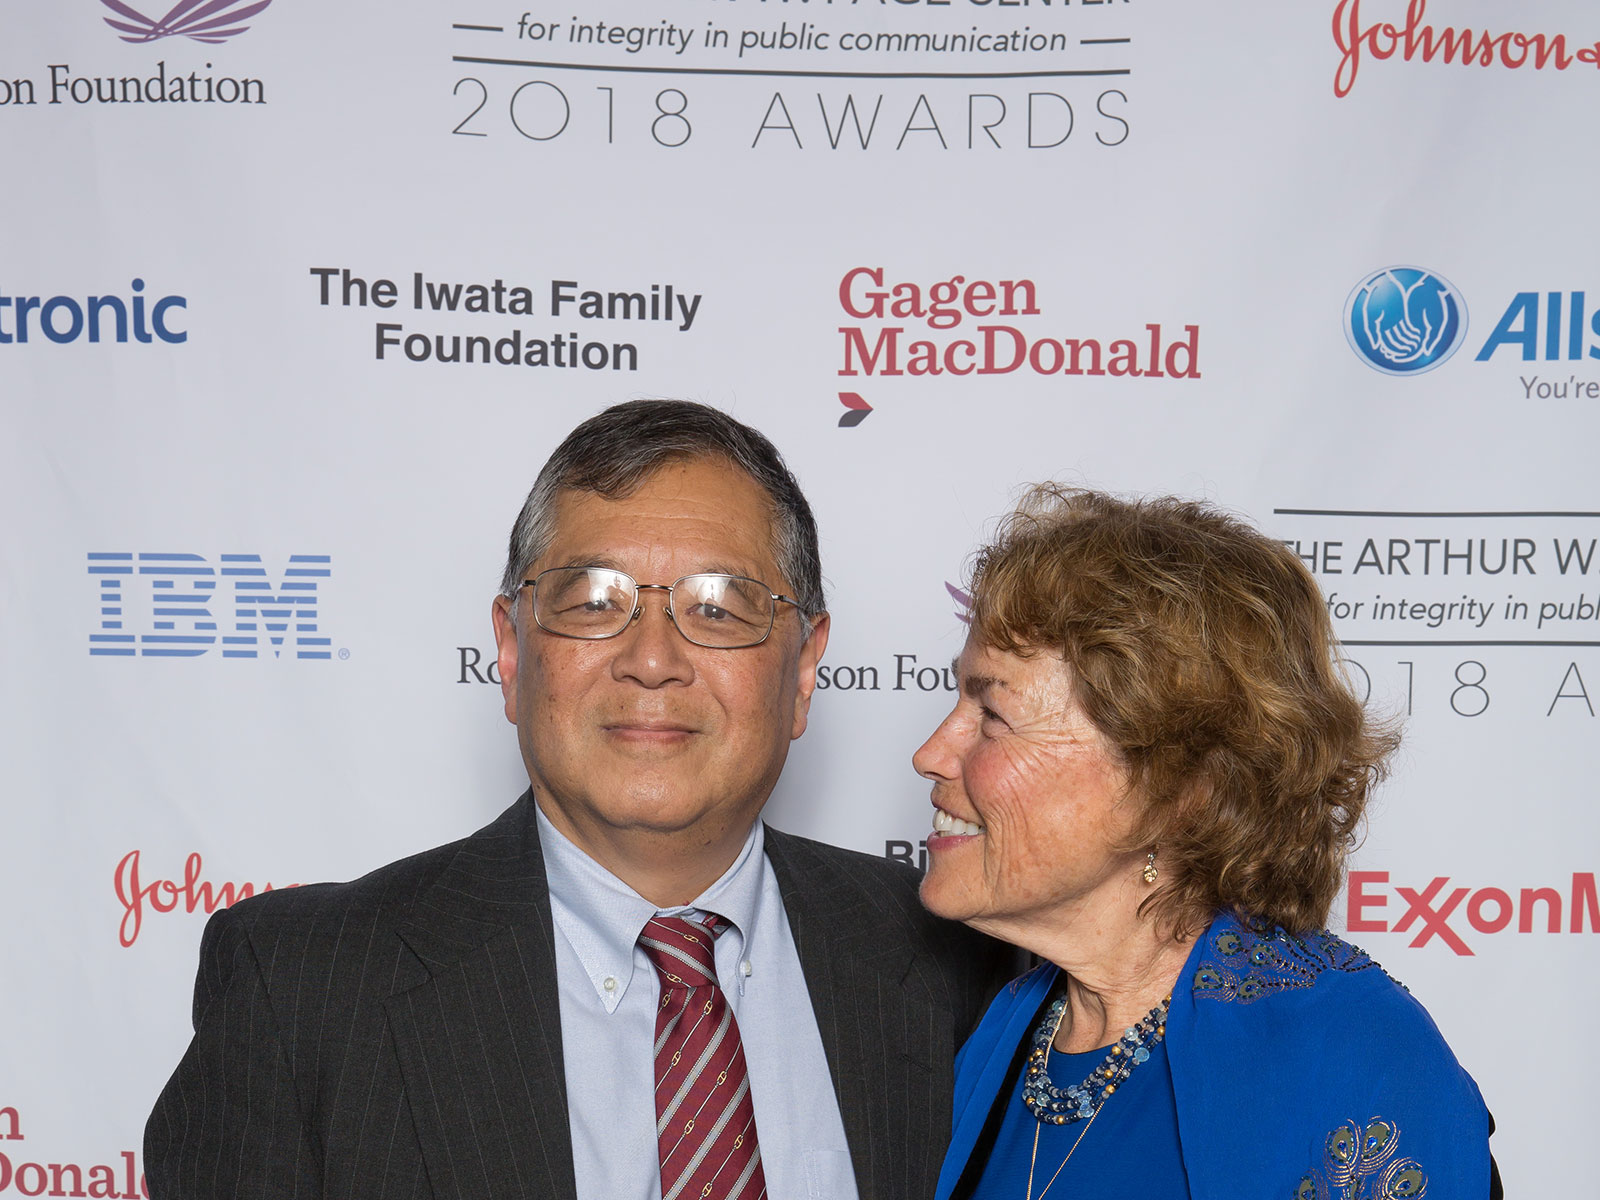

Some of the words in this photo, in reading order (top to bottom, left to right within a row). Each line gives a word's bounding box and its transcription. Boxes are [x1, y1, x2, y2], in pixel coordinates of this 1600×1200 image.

[517, 14, 560, 42] for
[569, 16, 693, 54] integrity
[704, 22, 729, 48] in
[739, 22, 829, 57] public
[838, 26, 1067, 52] communication
[47, 60, 268, 105] Foundation
[452, 77, 692, 148] 2018
[751, 89, 1131, 151] AWARDS
[310, 267, 398, 308] The
[414, 272, 534, 315] Iwata
[551, 280, 702, 331] Family
[839, 266, 1041, 330] Gagen
[376, 323, 638, 371] Foundation
[838, 323, 1202, 379] MacDonald
[1519, 375, 1600, 400] You're
[1353, 538, 1537, 576] ARTHUR
[87, 552, 332, 660] IBM
[1372, 594, 1494, 628] integrity
[1504, 594, 1528, 620] in
[814, 663, 880, 691] son
